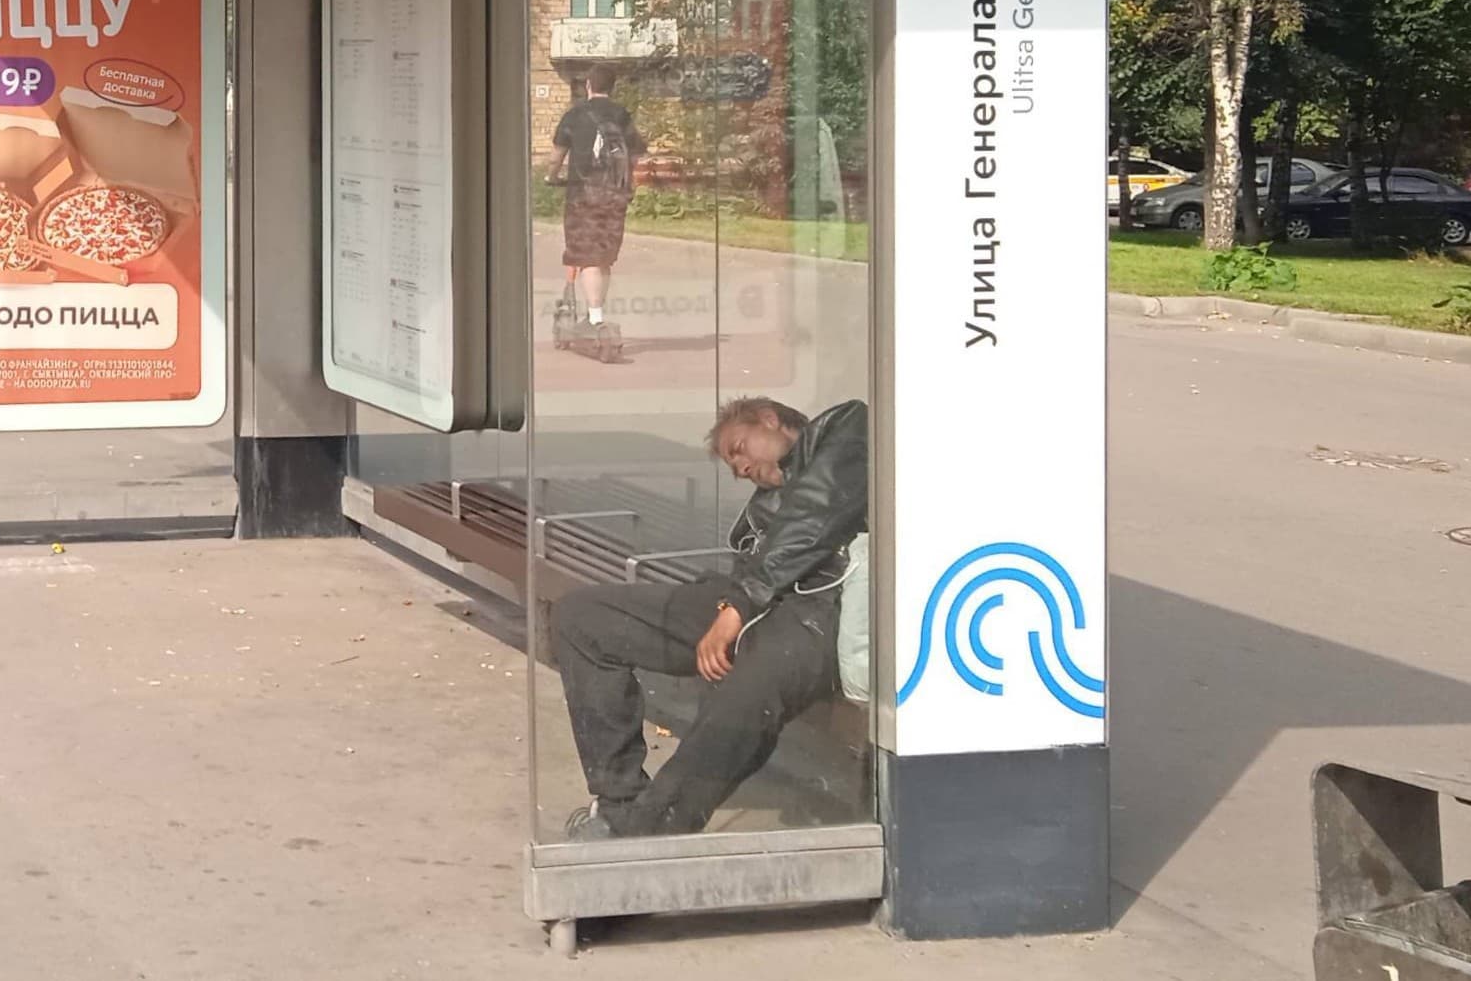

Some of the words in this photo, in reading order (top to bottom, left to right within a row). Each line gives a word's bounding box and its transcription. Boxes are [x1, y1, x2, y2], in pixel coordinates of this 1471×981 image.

[99, 64, 166, 90] Бесплатная
[1012, 39, 1035, 114] Ulitsa
[102, 80, 156, 101] доставка
[964, 216, 1000, 348] Улица
[59, 306, 160, 330] ПИЦЦА
